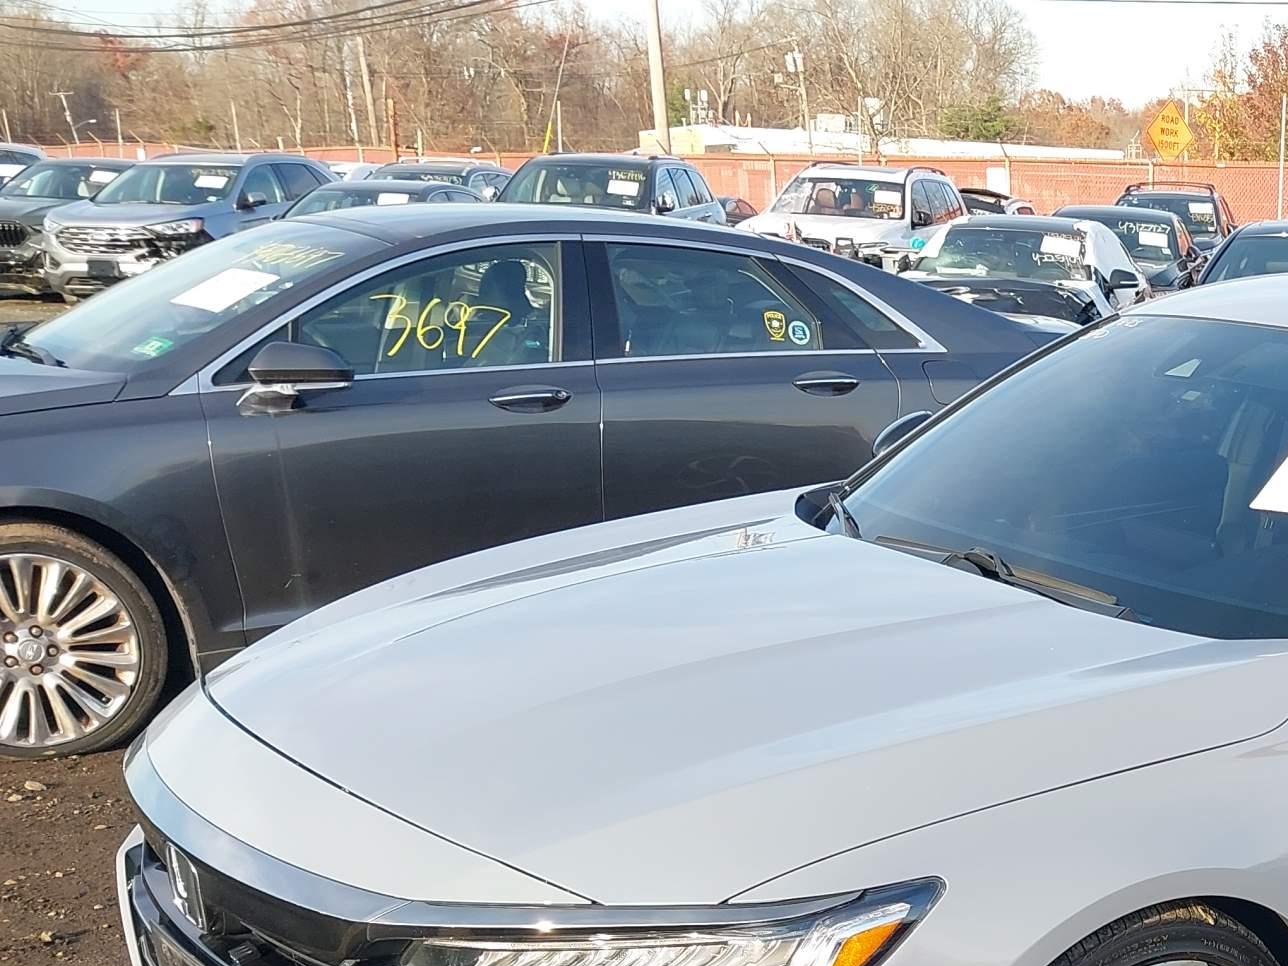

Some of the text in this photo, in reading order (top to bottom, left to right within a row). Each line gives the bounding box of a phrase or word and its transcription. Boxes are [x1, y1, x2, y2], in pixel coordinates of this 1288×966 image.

[1161, 114, 1180, 125] ROAD
[1160, 127, 1179, 139] WORK
[369, 293, 511, 359] 3697
